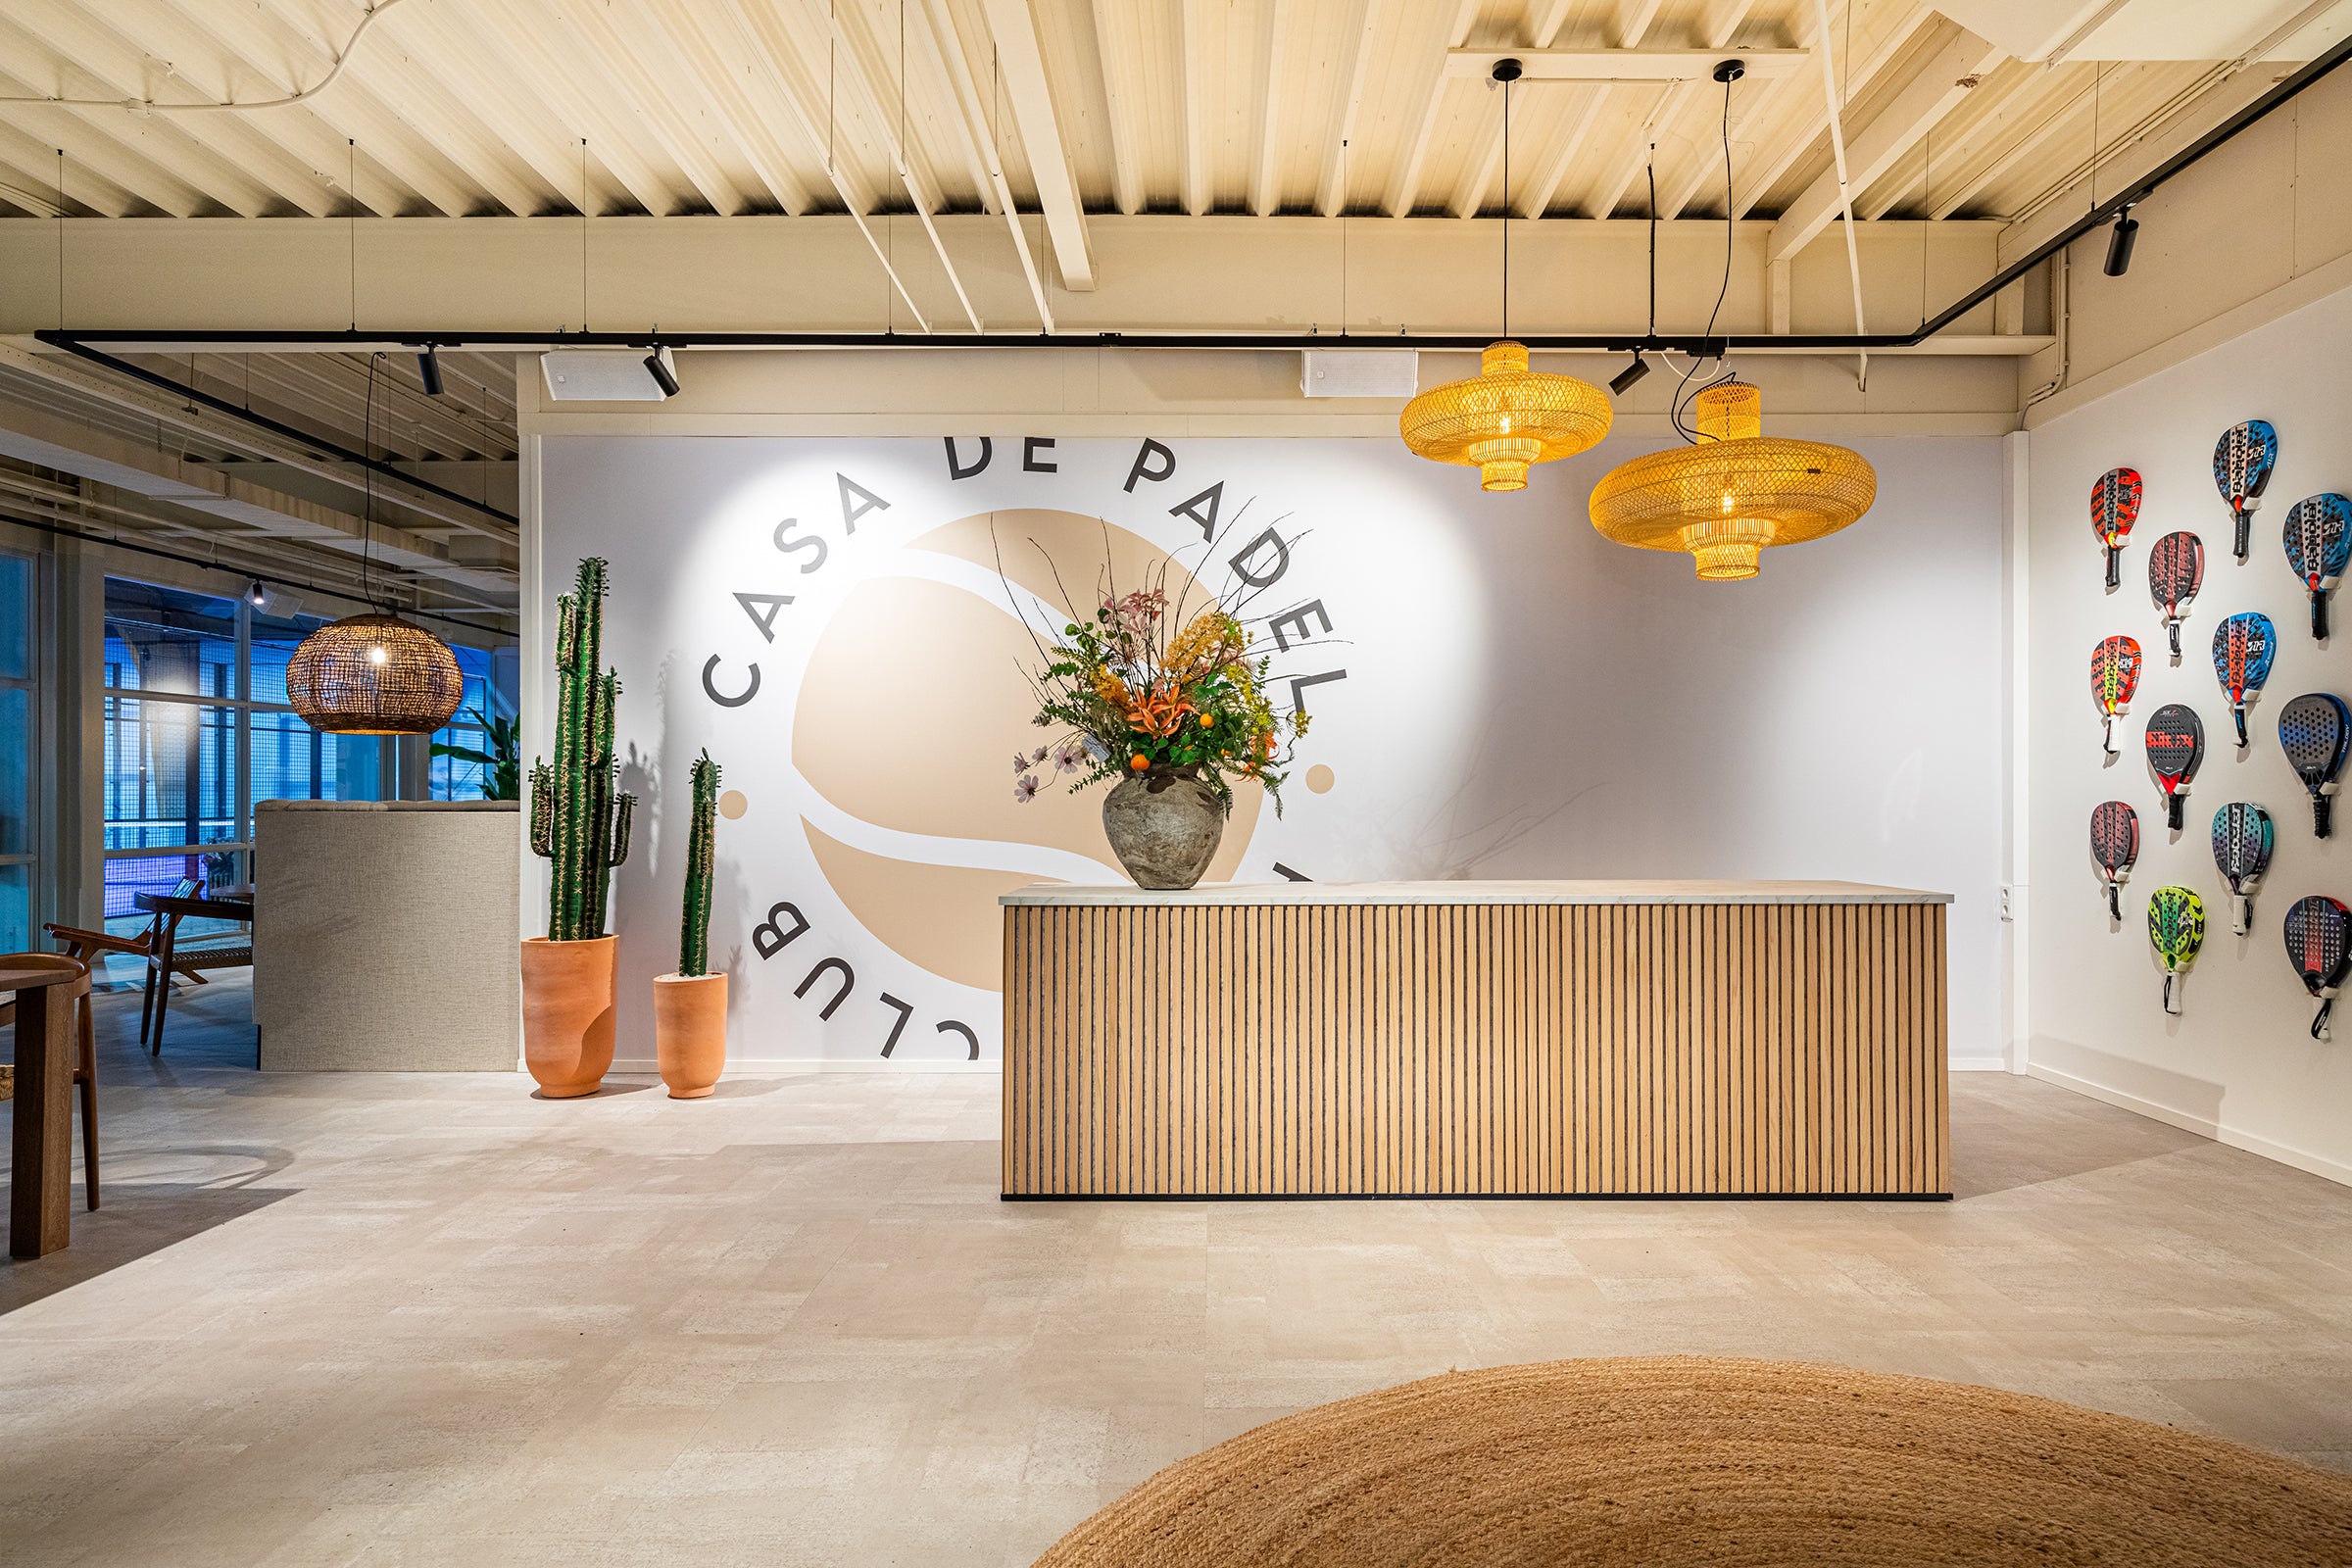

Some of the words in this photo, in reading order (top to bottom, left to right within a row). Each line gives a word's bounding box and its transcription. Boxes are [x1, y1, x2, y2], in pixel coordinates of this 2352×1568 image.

[2233, 426, 2244, 494] Babolat
[2306, 500, 2319, 571] Babolat
[702, 472, 891, 708] CASA
[1124, 438, 1348, 713] PADEL
